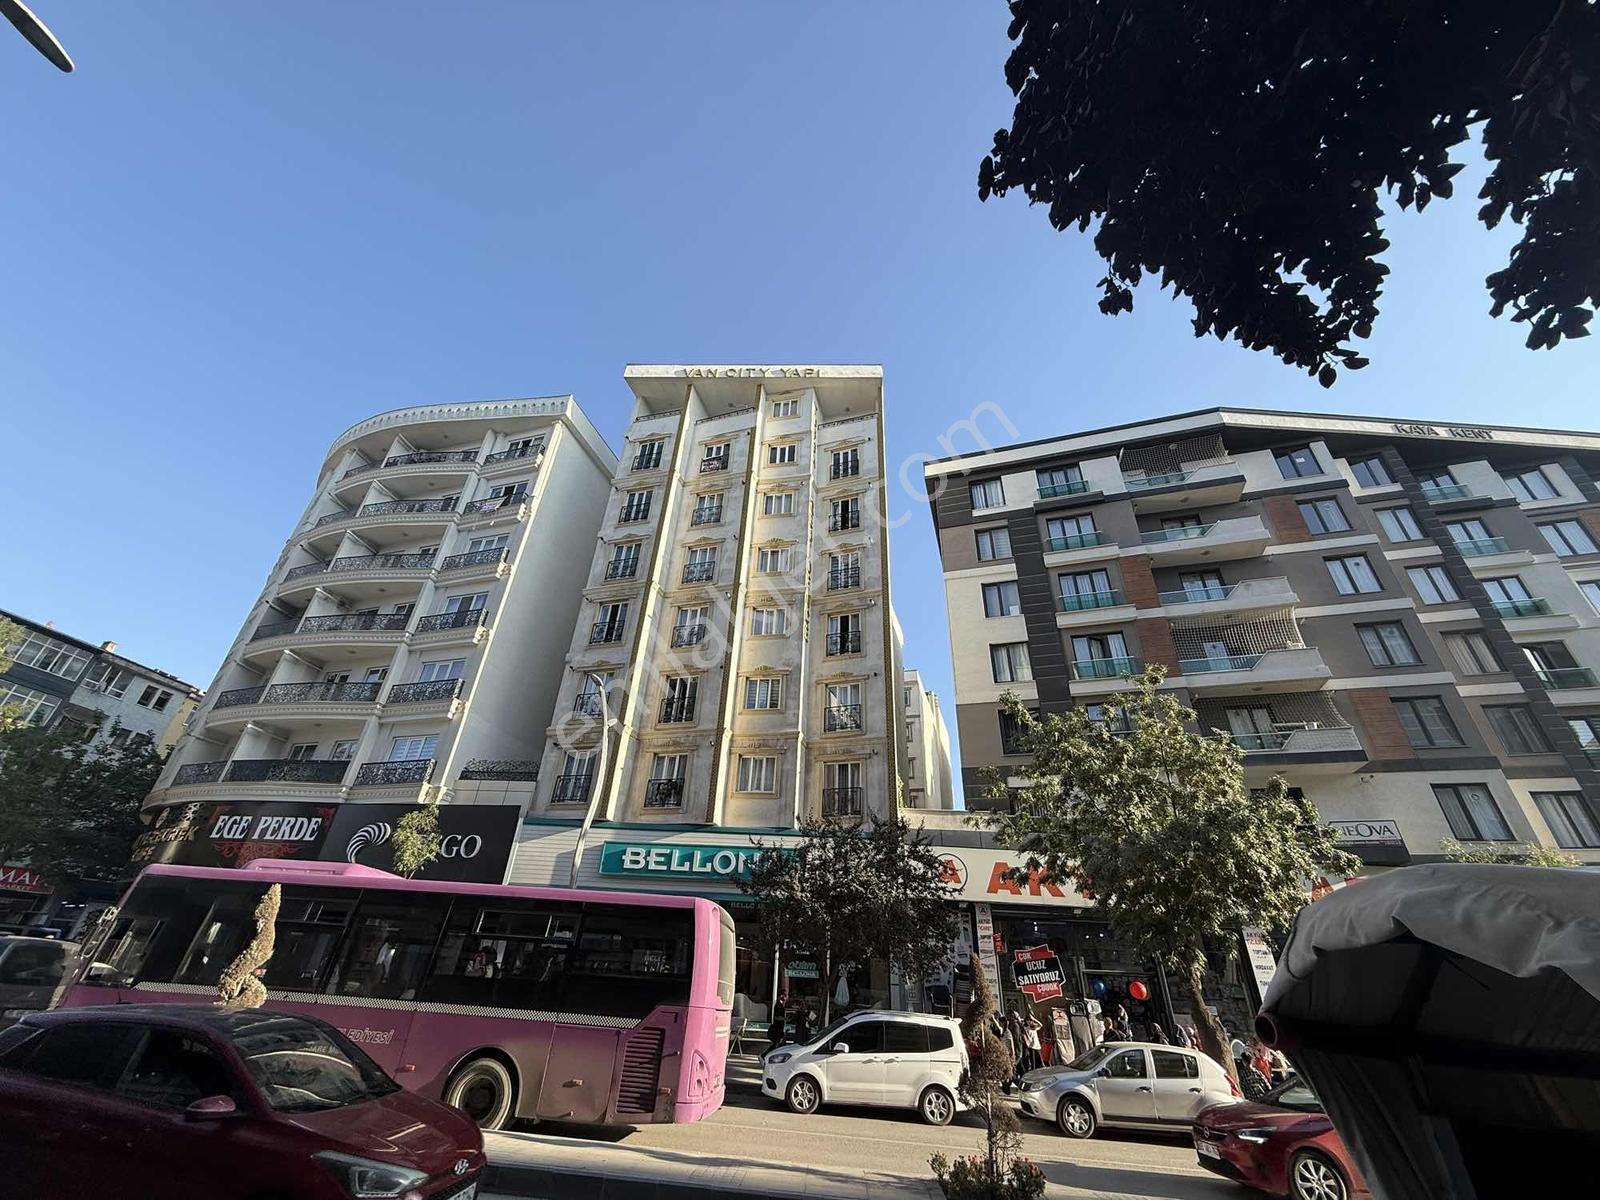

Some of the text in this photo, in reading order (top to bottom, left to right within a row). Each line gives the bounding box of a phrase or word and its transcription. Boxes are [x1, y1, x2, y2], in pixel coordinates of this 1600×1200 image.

[684, 368, 820, 378] VAN CITY YAPI
[1394, 424, 1494, 440] KAYA KENT
[209, 815, 251, 840] EGE
[251, 816, 322, 842] PERDE
[440, 834, 482, 859] GO
[622, 847, 762, 874] BELLON
[1026, 960, 1047, 971] UCUZ
[1018, 971, 1061, 986] SATIYORUZ
[336, 1028, 395, 1045] EDİYESİ
